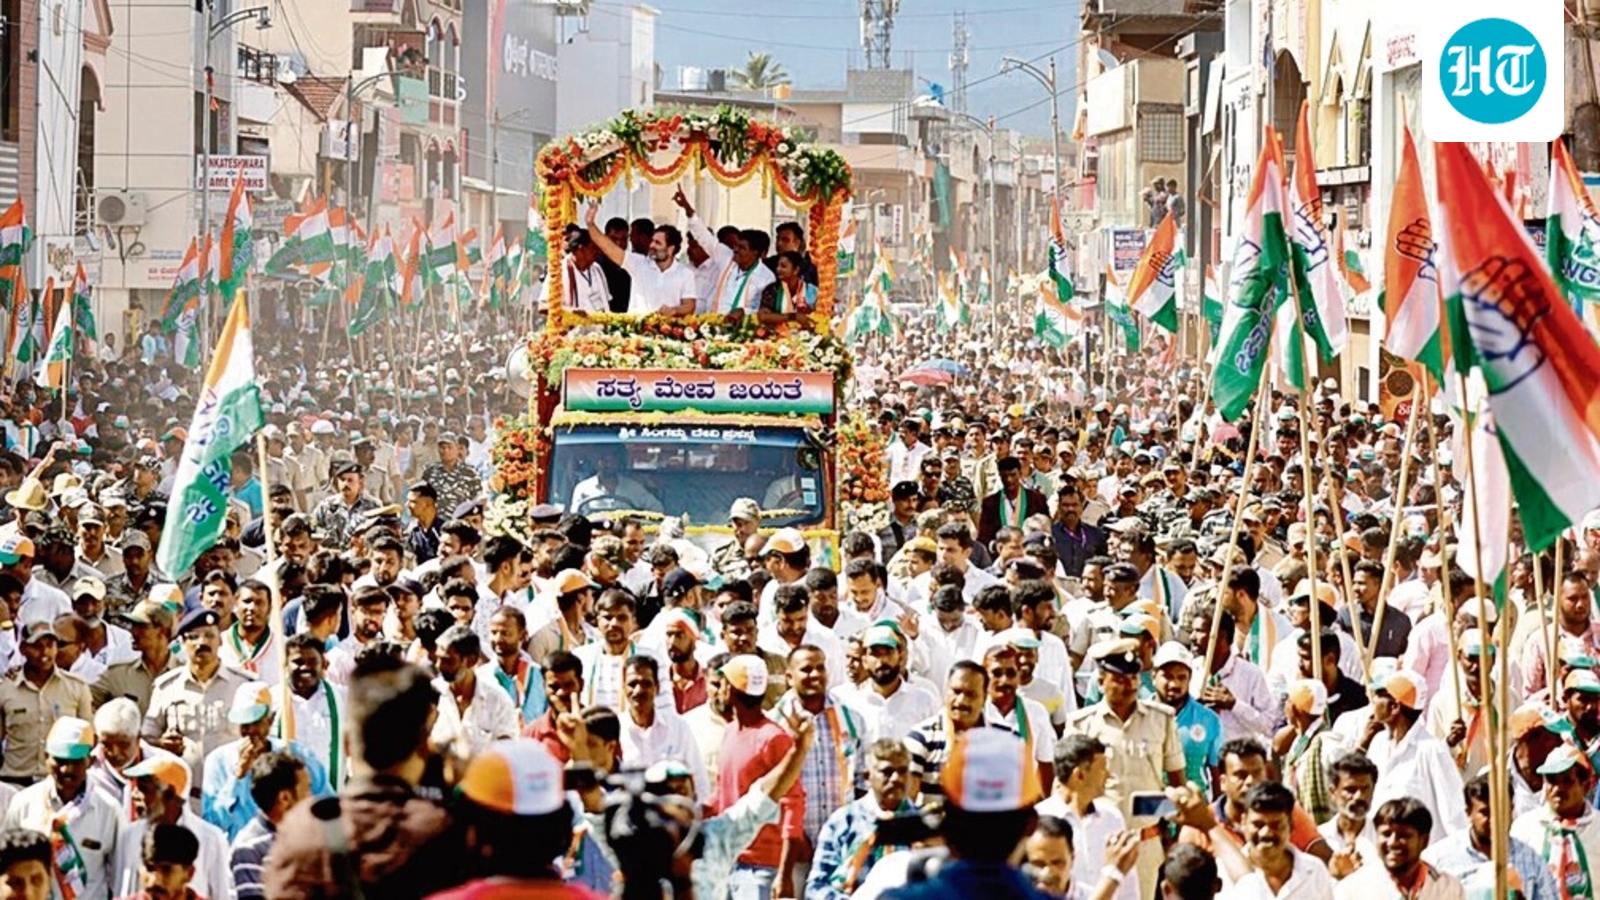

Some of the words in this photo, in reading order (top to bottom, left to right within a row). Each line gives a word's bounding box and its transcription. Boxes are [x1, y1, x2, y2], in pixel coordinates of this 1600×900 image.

[199, 157, 264, 169] VNKATESHWARA
[198, 177, 229, 187] FAME
[597, 376, 643, 408] ಸತ್ಯ
[654, 376, 716, 400] ಮೇವ
